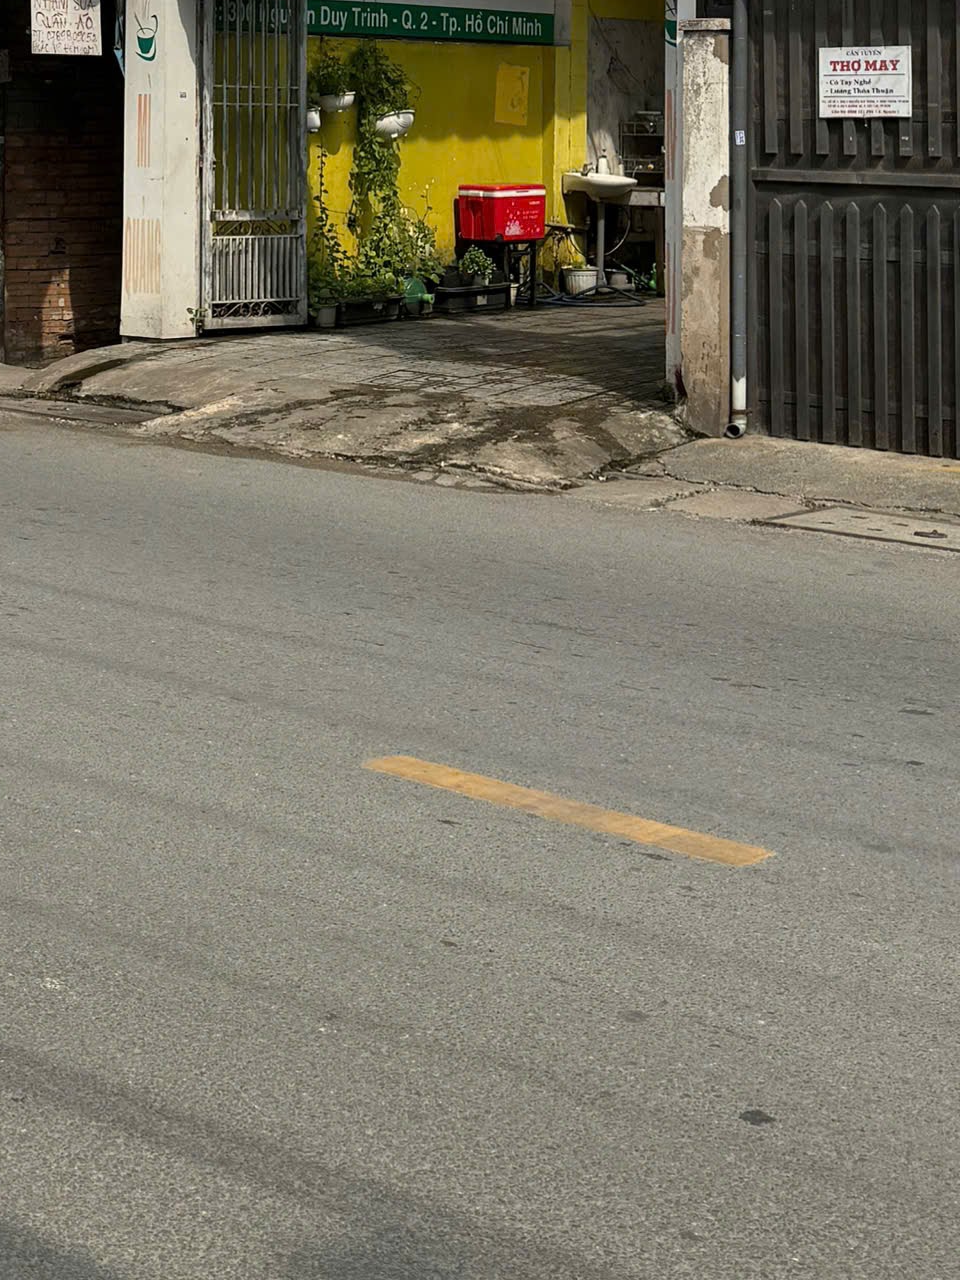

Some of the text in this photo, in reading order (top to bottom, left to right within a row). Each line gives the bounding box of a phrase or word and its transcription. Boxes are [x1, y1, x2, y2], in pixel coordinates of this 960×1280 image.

[320, 5, 347, 30] Duy
[352, 6, 388, 28] Trinh
[401, 9, 416, 30] Q.
[420, 12, 428, 30] 2
[440, 12, 461, 36] Tp.
[465, 11, 483, 33] Hồ
[487, 15, 508, 35] Chí
[512, 17, 542, 36] Minh
[829, 59, 900, 74] THỢ MAY
[841, 79, 852, 87] Tay
